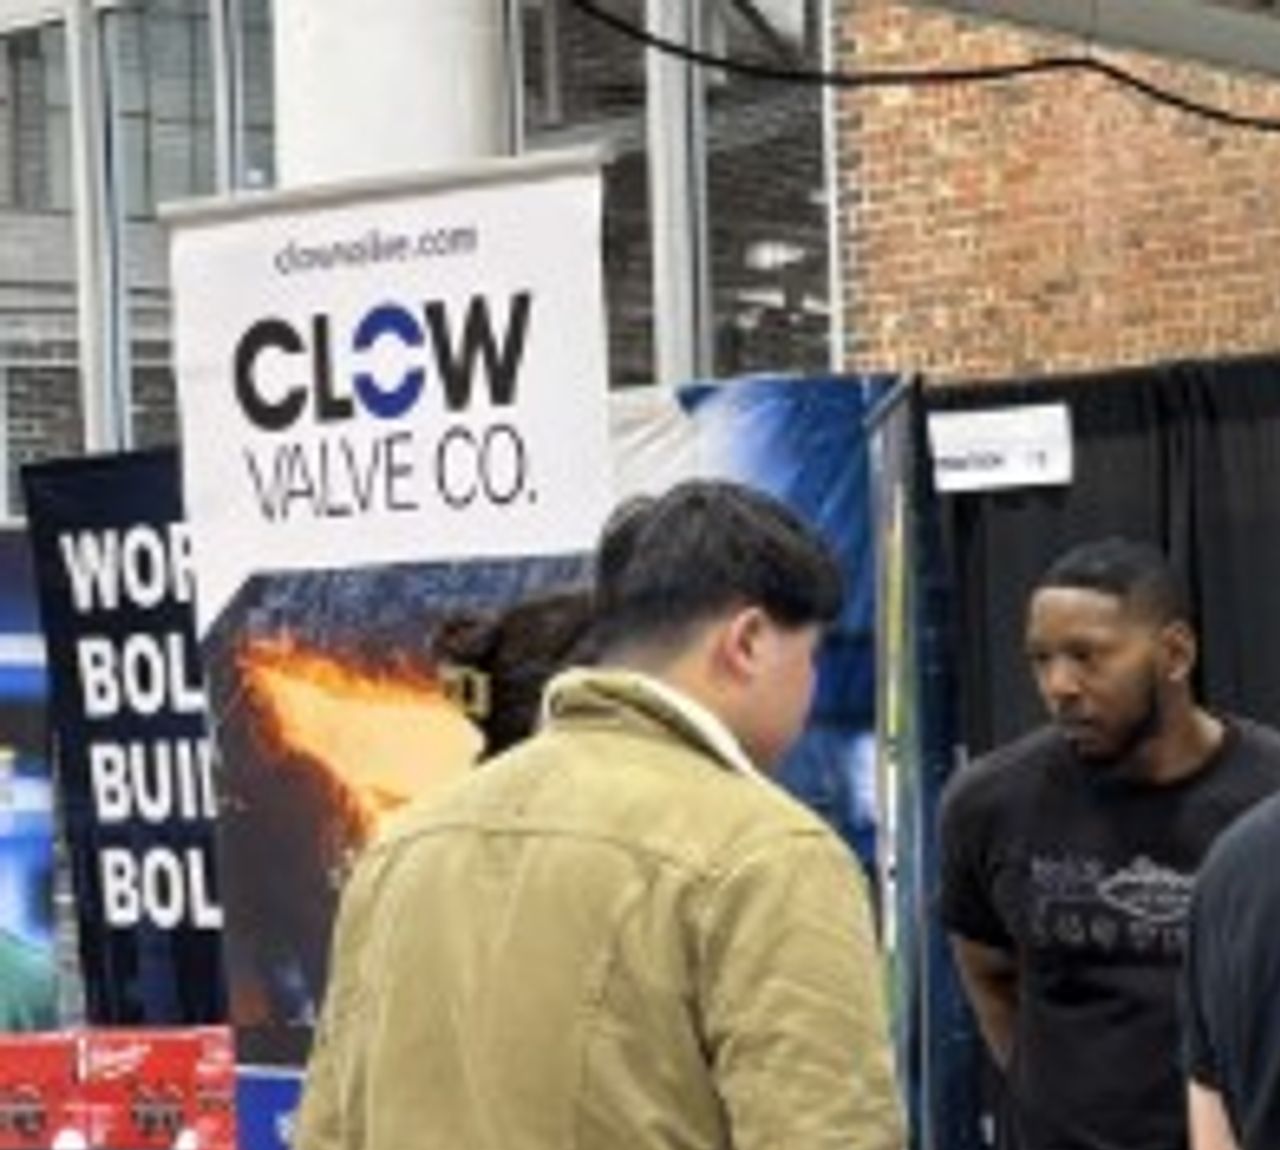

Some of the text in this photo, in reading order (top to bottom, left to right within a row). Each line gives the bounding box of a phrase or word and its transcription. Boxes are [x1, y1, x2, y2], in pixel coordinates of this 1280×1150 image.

[233, 290, 531, 432] CLOW
[243, 421, 538, 523] VALVE CO.
